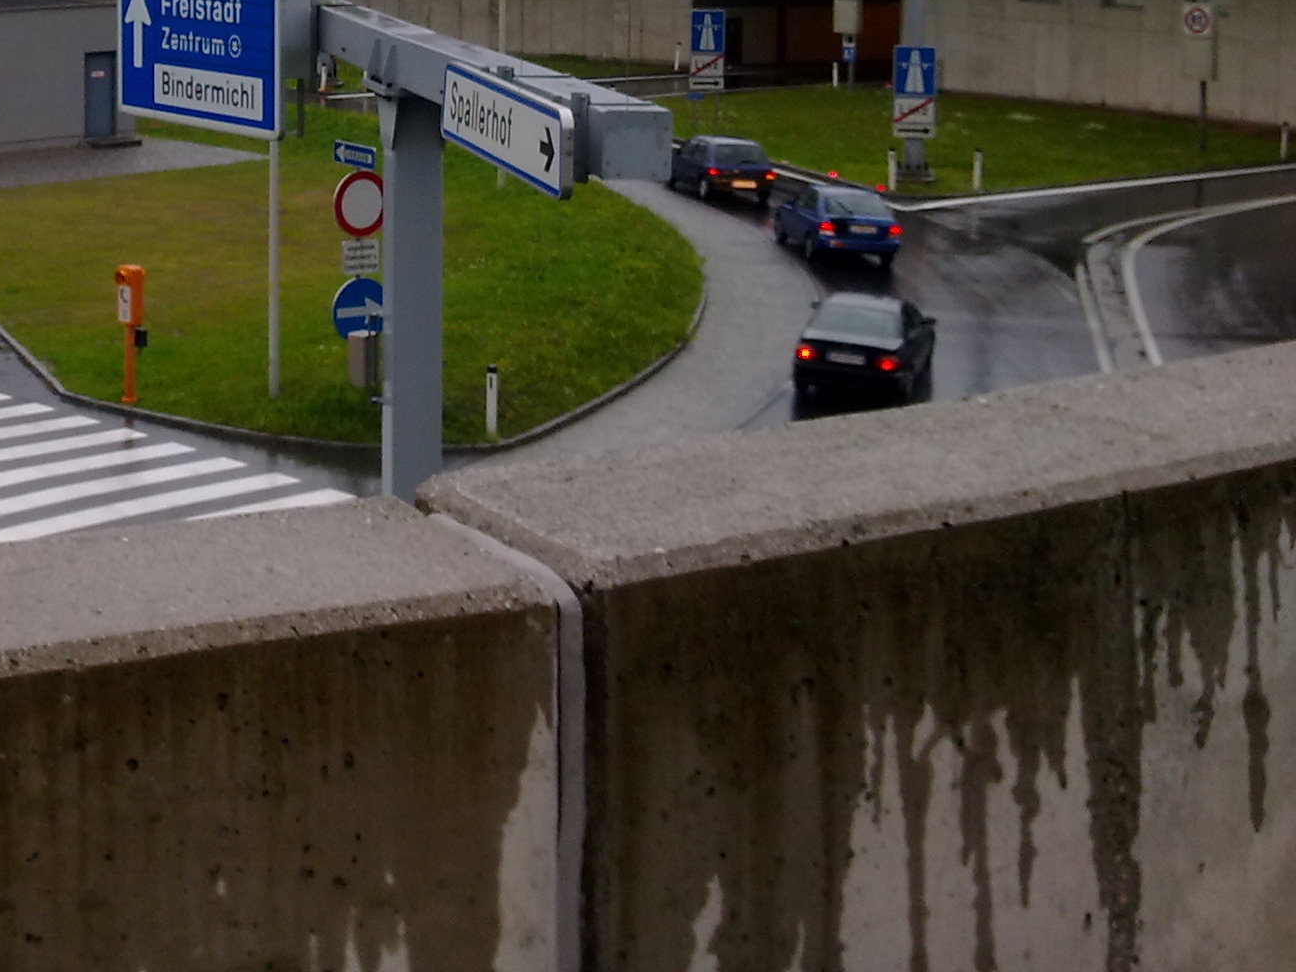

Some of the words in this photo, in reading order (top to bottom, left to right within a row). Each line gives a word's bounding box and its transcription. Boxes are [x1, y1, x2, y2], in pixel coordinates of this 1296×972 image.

[161, 27, 225, 56] Zentrum
[162, 71, 255, 110] Bindermichl
[450, 81, 513, 149] Spallerhof
